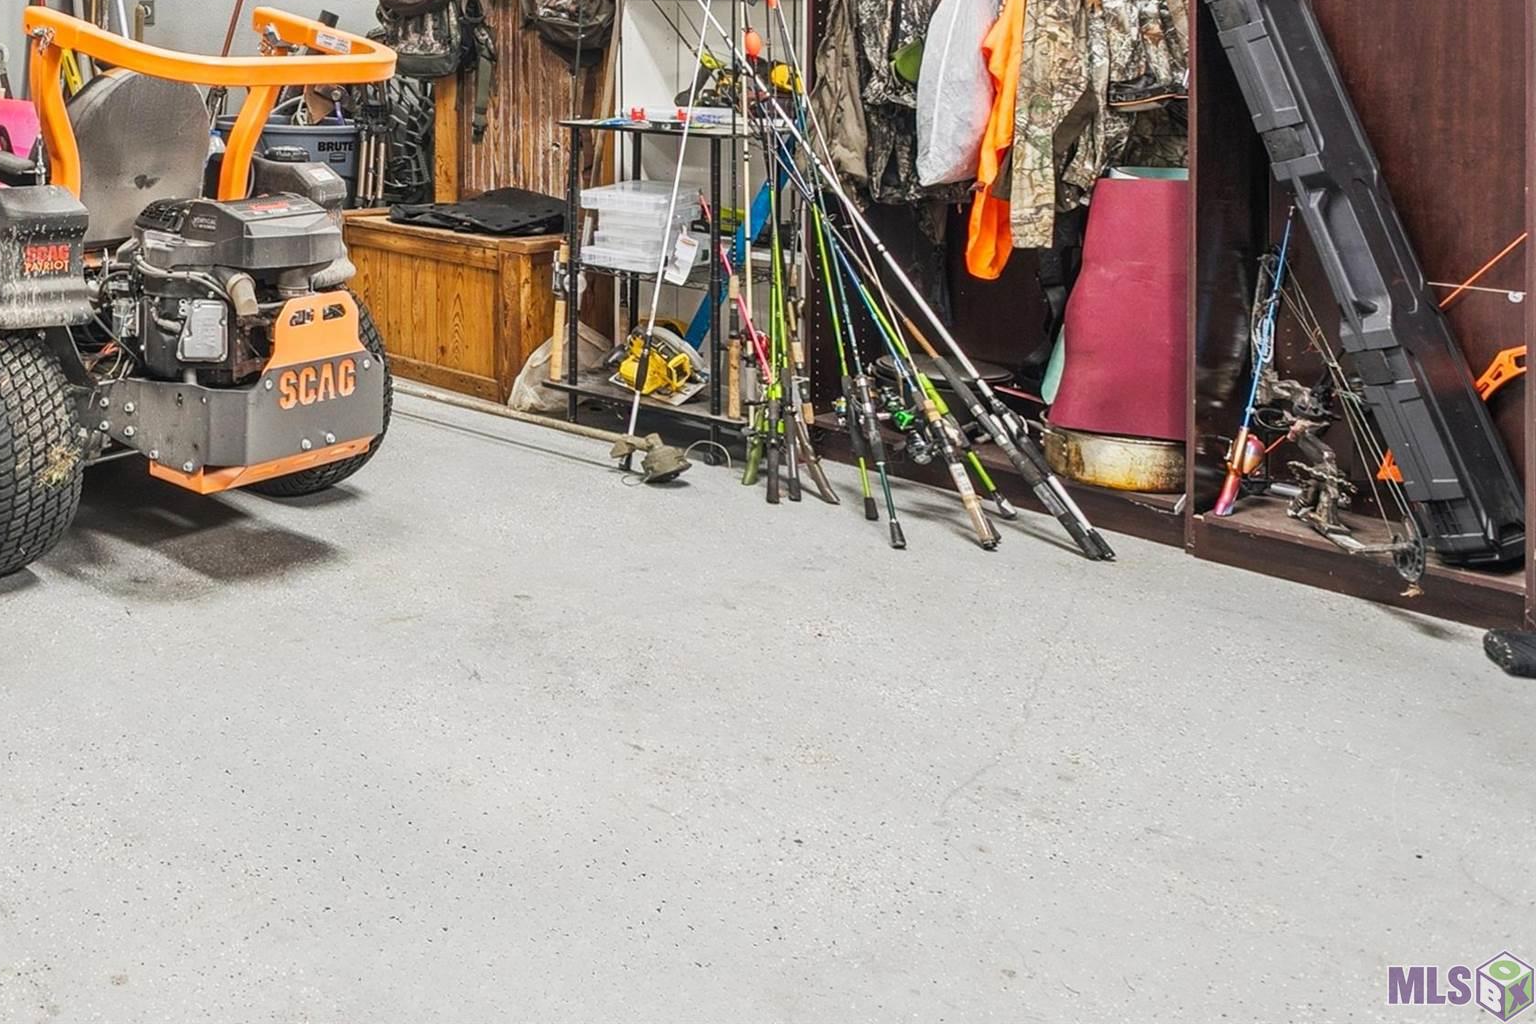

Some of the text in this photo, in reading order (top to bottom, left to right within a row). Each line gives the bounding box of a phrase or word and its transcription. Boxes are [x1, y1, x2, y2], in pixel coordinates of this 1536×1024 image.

[318, 141, 353, 152] BRUTE
[26, 244, 69, 262] SCAG
[24, 260, 70, 273] PATRIOT
[279, 357, 356, 410] SCAG
